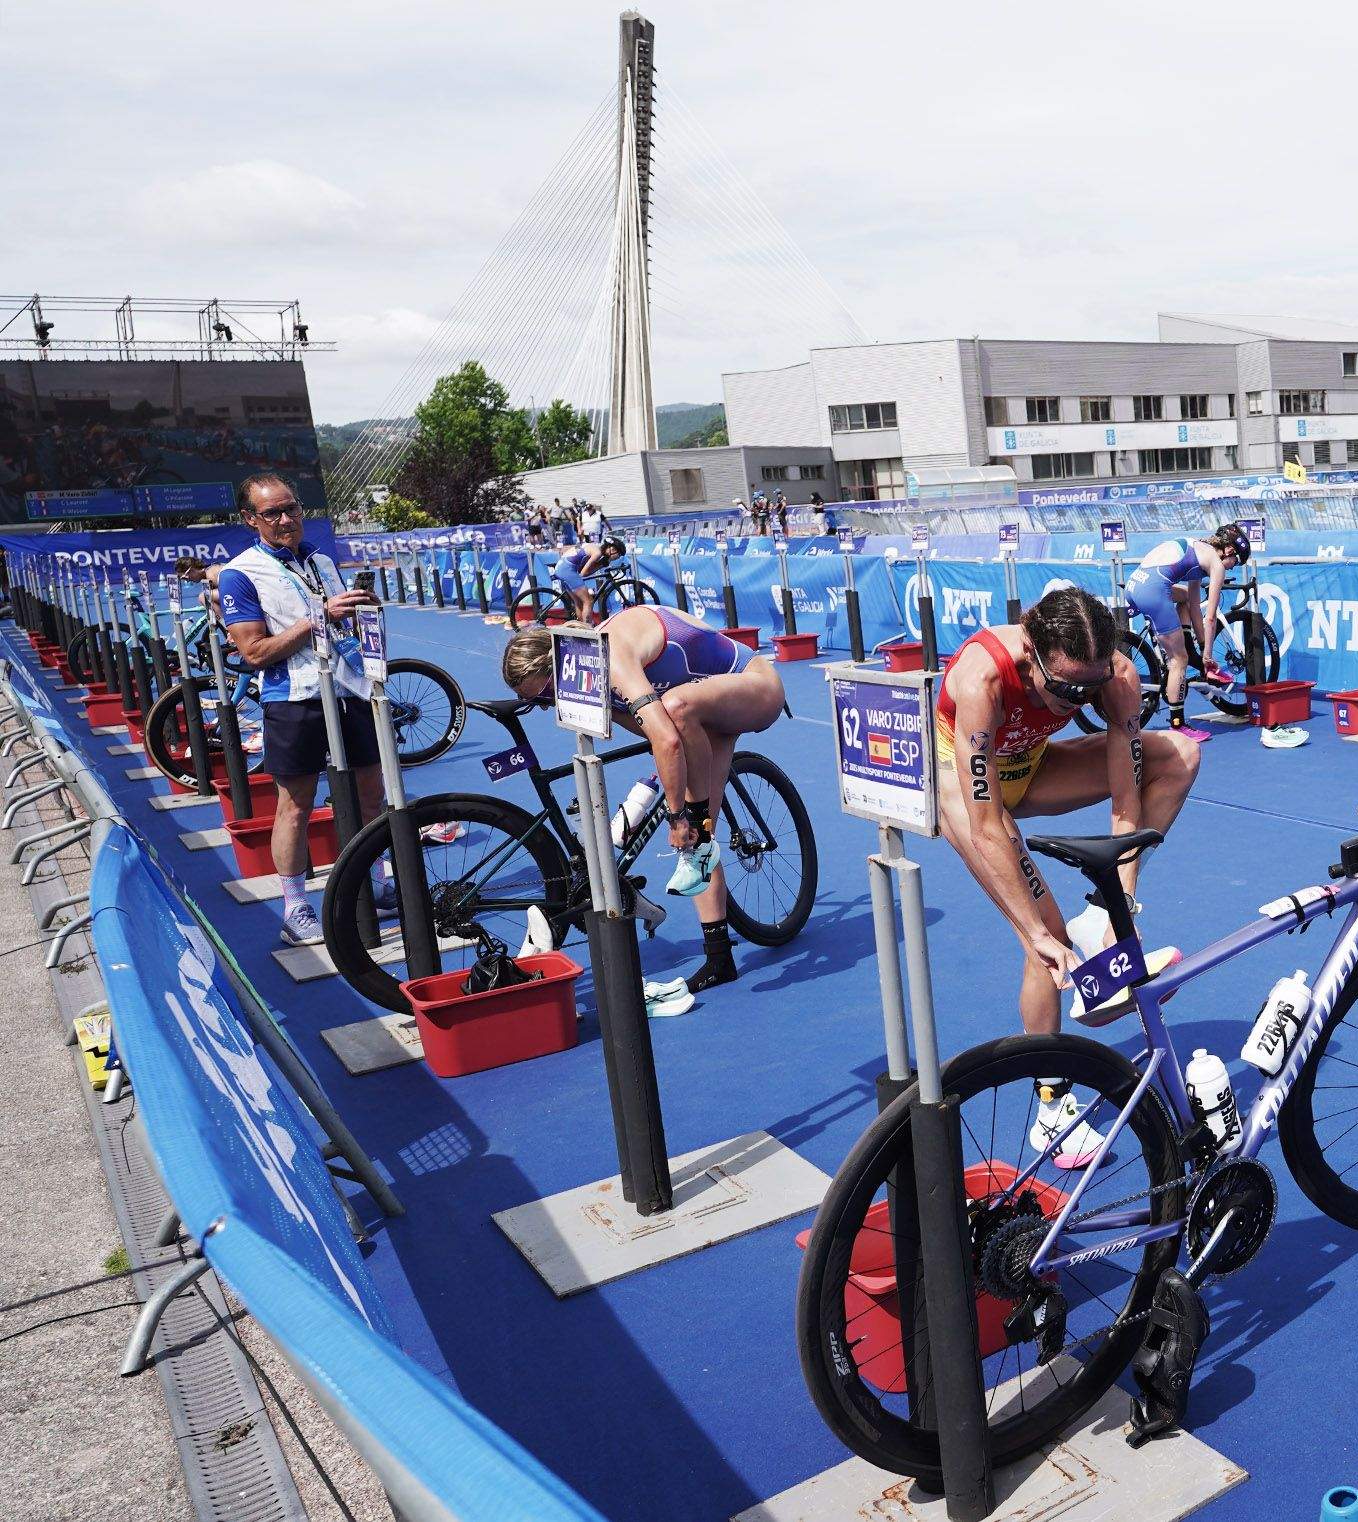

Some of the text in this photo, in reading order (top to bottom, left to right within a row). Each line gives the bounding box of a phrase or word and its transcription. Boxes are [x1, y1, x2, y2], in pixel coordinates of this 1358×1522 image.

[1032, 491, 1098, 505] Pontevedra
[55, 543, 230, 567] PONTEVEDRA
[349, 528, 486, 556] Pontevedra
[941, 587, 993, 627] NTT
[562, 653, 576, 682] 64
[454, 705, 464, 728] SWISS
[1339, 709, 1347, 718] 67
[842, 707, 862, 749] 62
[866, 709, 892, 729] VARO
[509, 752, 525, 766] 66
[891, 738, 919, 767] ESP
[179, 774, 198, 784] DT
[969, 753, 992, 803] 62
[1019, 856, 1046, 900] 62
[1109, 952, 1133, 978] 62
[1068, 1238, 1138, 1267] SPECIALIZED
[830, 1332, 847, 1377] ZIPP
